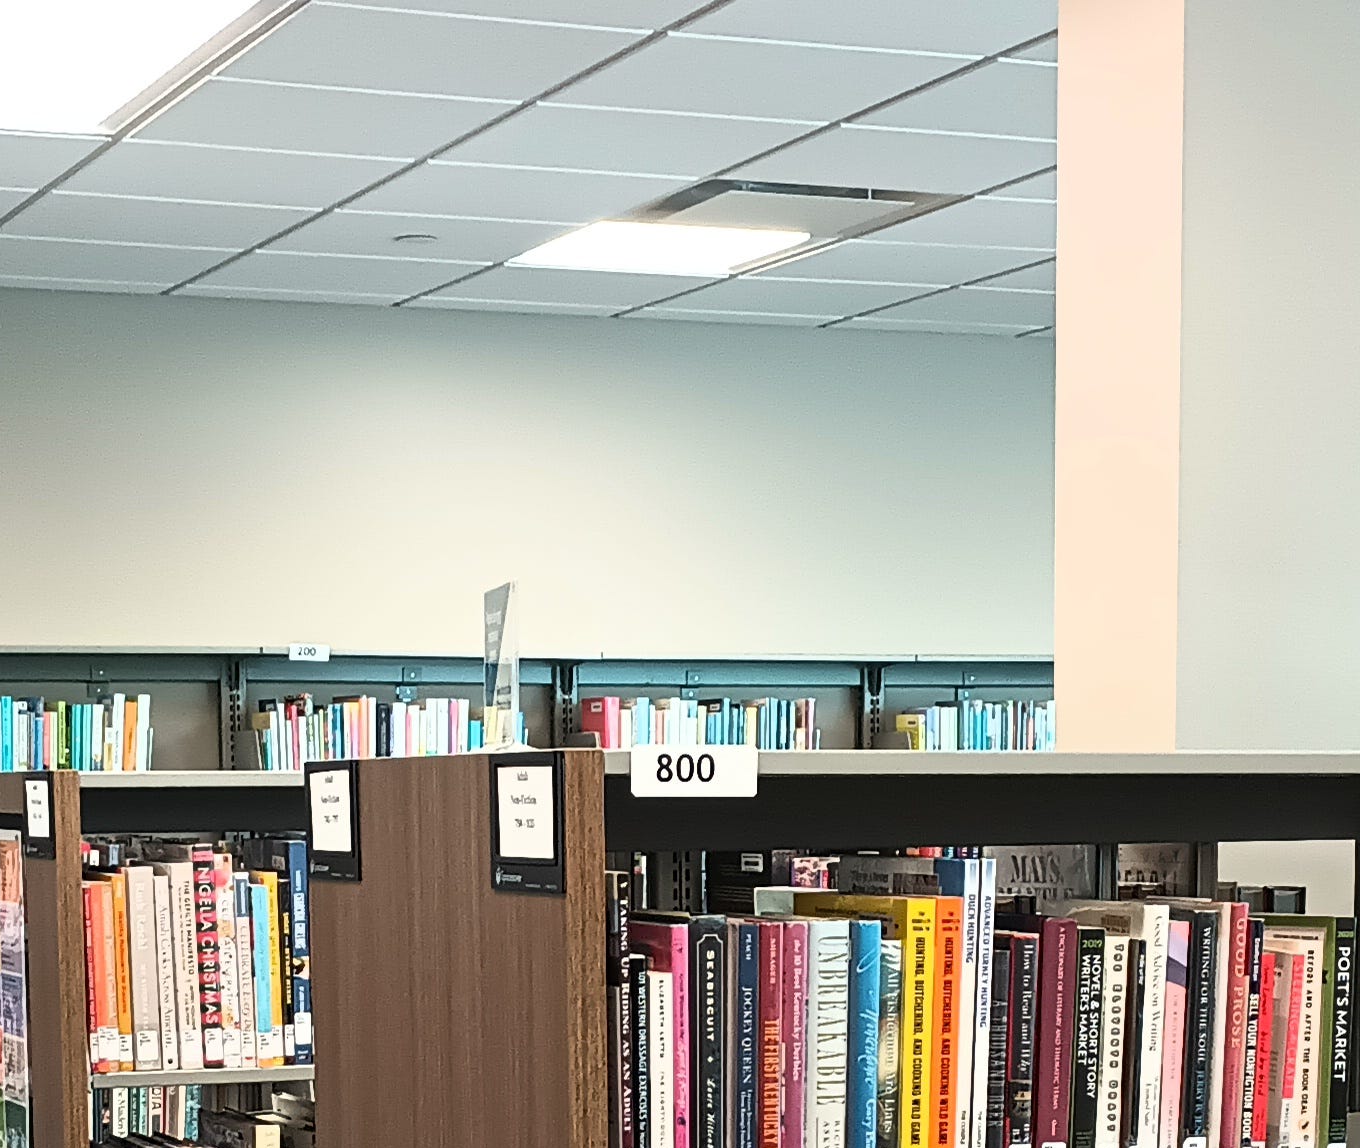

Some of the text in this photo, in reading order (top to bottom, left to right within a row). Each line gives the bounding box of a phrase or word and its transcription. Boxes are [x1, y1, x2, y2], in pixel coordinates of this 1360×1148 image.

[655, 753, 716, 783] 800
[198, 868, 219, 1024] NIGELLA CHRISTMAS
[965, 894, 976, 964] DUCK HUNTING
[979, 896, 992, 1028] ADVANCED TURKEY HUNTING
[1231, 918, 1247, 1049] GOOD PROSE
[706, 950, 715, 1041] SEABISCUIT
[741, 986, 753, 1083] JOCKEY QUEEN
[764, 1019, 779, 1042] THE
[817, 935, 849, 1106] UNBREAKABLE
[939, 937, 954, 1145] HUNTING, BUTCHERING, AND COOKING WILD GAME
[1077, 954, 1092, 1065] WRITER'S MARKET
[1082, 940, 1102, 1098] 2019 NOVEL & SHORT STORY
[1195, 927, 1211, 1102] WRITING FOR THE SOUL JERRY
[1333, 946, 1351, 1082] POET'S MARKET
[763, 1046, 779, 1078] FIRST
[763, 1083, 779, 1143] KENTUCKY
[1242, 994, 1259, 1138] SELL YOUR NONFICTION BOOK
